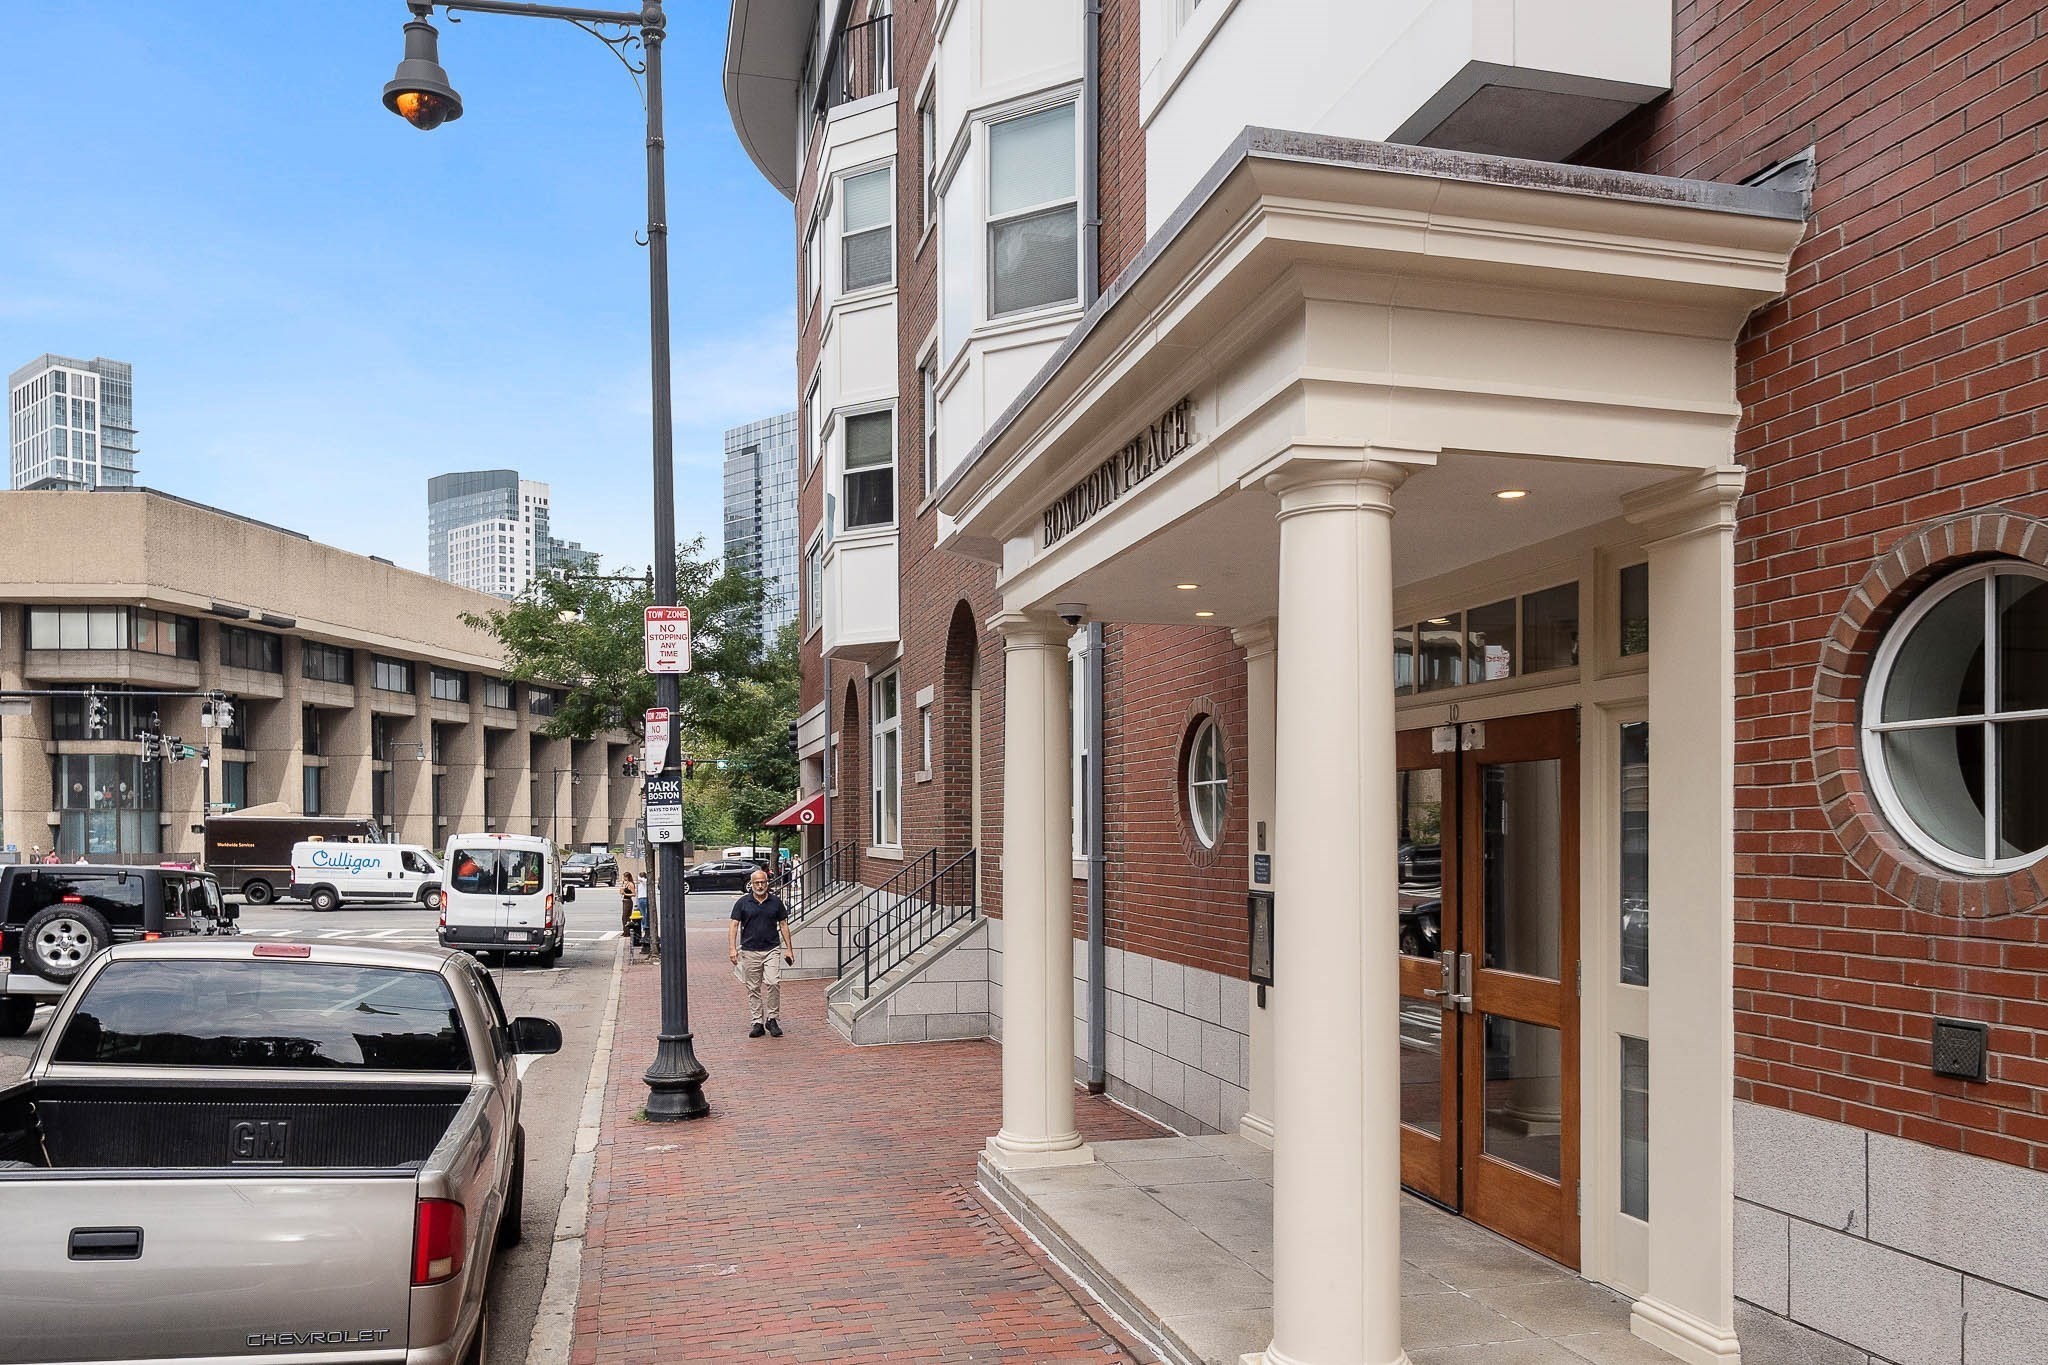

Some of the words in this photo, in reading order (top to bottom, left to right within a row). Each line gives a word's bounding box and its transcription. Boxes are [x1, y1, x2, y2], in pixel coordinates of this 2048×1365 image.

[1043, 455, 1118, 549] BOWDOIN
[1121, 398, 1192, 493] PLACE
[647, 610, 663, 619] TOW
[666, 610, 687, 619] ZONE
[659, 624, 676, 632] NO
[649, 633, 688, 641] STOPPING
[1449, 704, 1459, 721] 10
[652, 725, 661, 733] NO
[647, 780, 679, 792] PARK
[648, 792, 680, 800] BOSTON
[659, 830, 670, 839] 59
[312, 850, 381, 874] Culligan
[233, 1121, 288, 1159] GM
[246, 1328, 390, 1347] CHEVROLET
